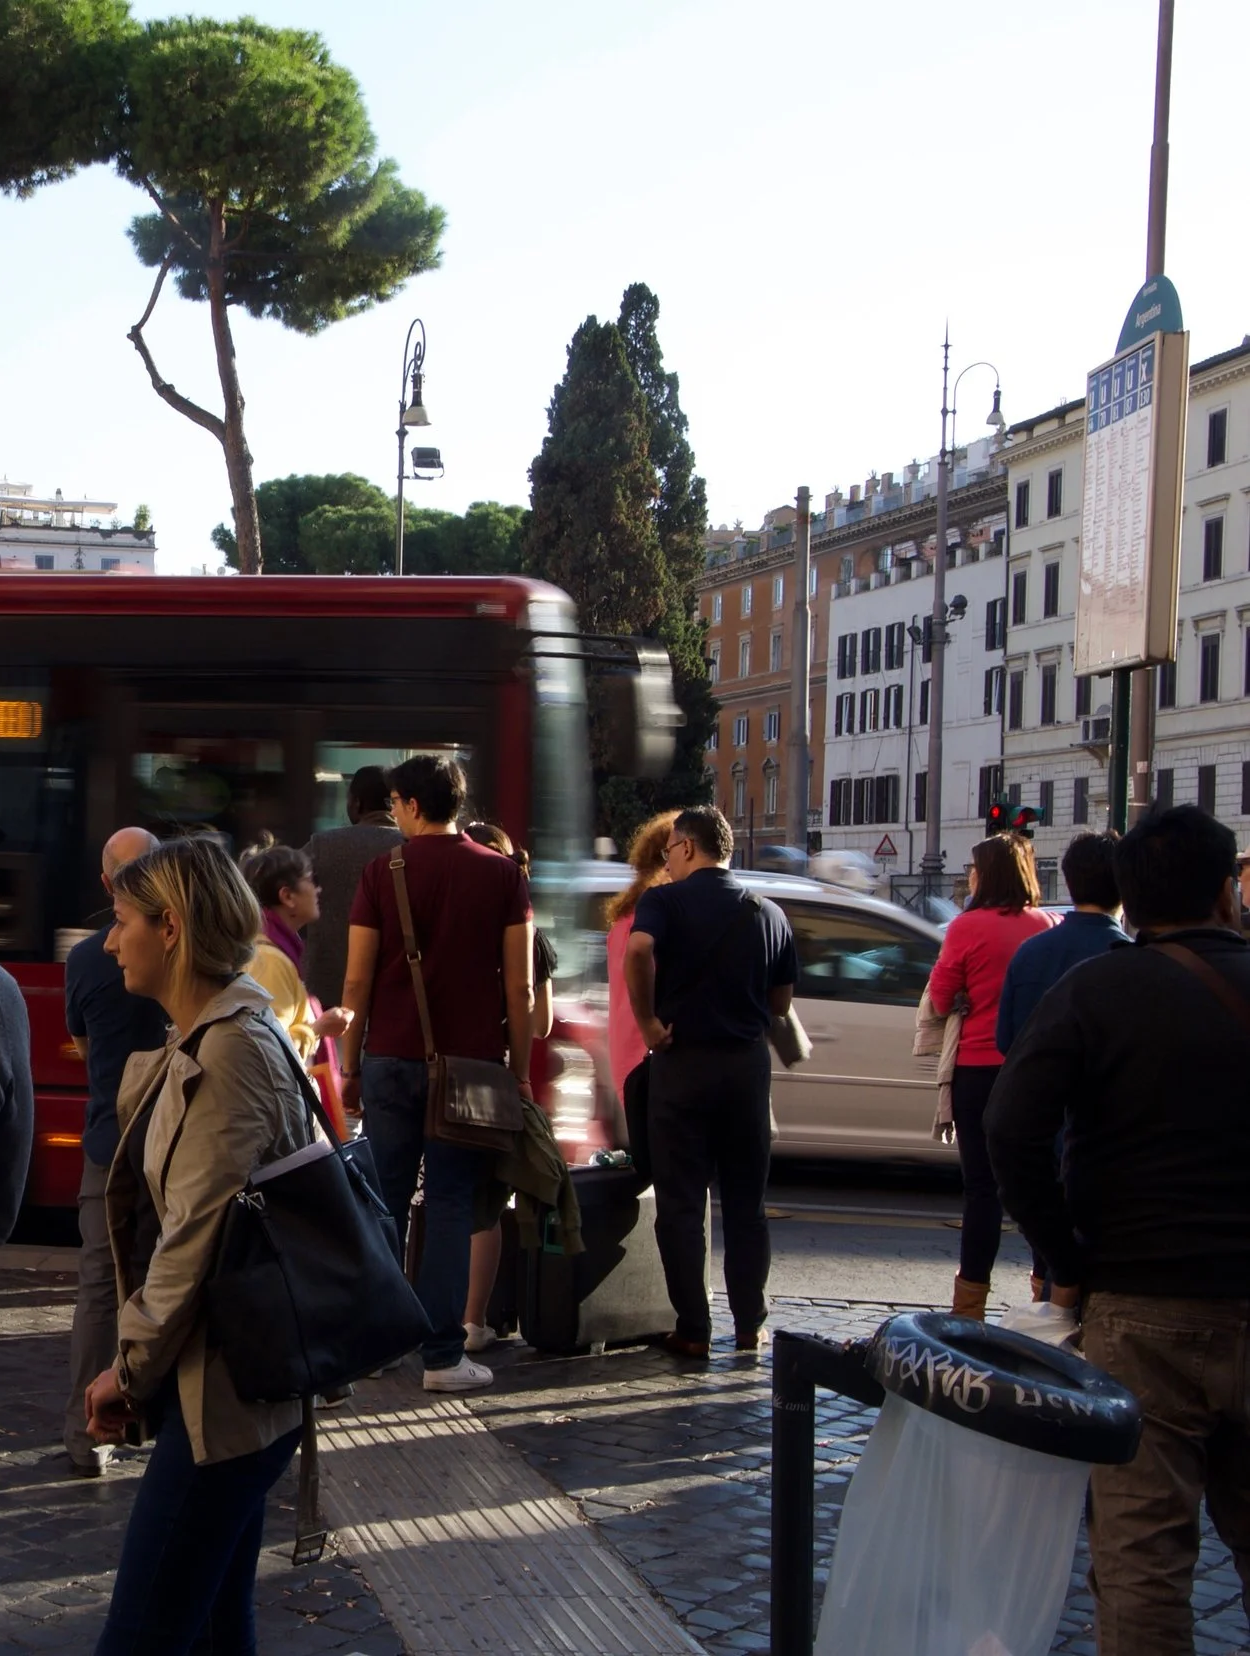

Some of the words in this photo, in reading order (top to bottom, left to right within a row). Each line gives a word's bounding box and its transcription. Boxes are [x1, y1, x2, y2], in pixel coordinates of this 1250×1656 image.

[1135, 303, 1161, 329] Argentina
[1101, 384, 1107, 405] U
[1114, 377, 1120, 398] U
[1127, 369, 1134, 391] U
[1140, 361, 1148, 382] X
[1140, 387, 1150, 407] 130
